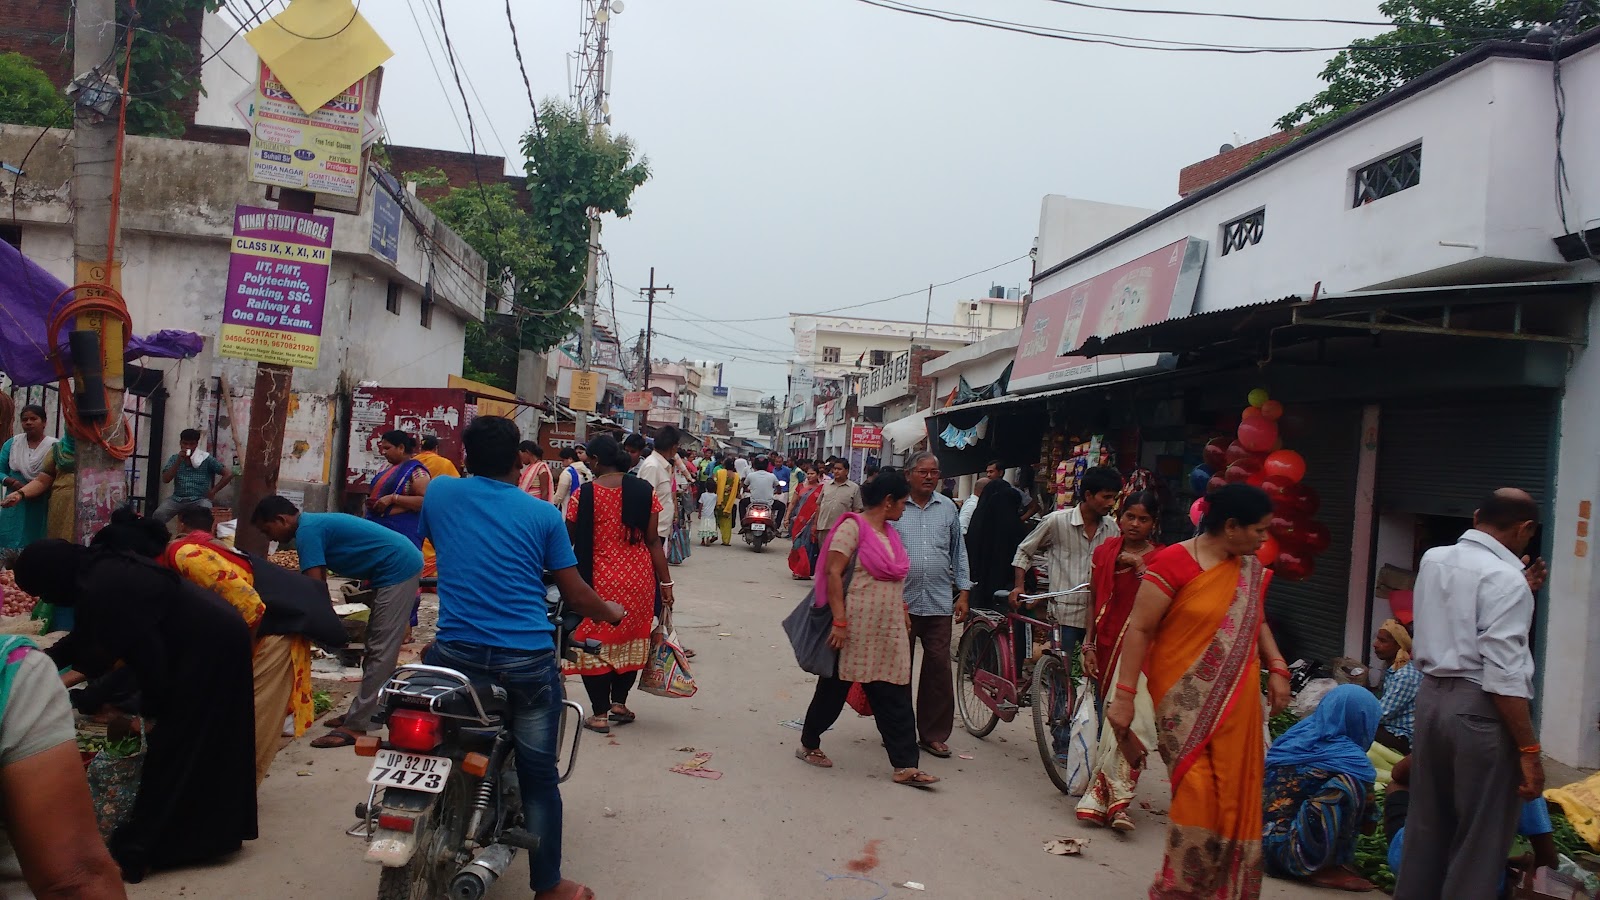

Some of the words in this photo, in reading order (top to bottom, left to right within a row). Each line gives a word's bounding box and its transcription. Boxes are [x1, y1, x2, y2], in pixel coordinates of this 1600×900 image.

[254, 163, 278, 172] INDIRA
[279, 167, 304, 176] NAGAR
[308, 172, 330, 181] GOMTI
[331, 176, 356, 186] NAGAR
[239, 214, 266, 230] VINAY
[267, 214, 296, 232] STUDY
[296, 218, 329, 242] CIRCLE
[236, 240, 267, 252] CLASS
[270, 244, 282, 256] IX,
[285, 246, 294, 256] X,
[297, 247, 309, 258] XI,
[312, 249, 325, 259] XII
[255, 261, 272, 274] IIT,
[275, 264, 301, 278] PMT,
[243, 272, 310, 292] Polytechnic,
[238, 284, 284, 300] Banking,
[287, 290, 313, 305] SSC,
[246, 298, 290, 314] Railway
[292, 304, 301, 314] &
[232, 308, 254, 320] One
[256, 312, 278, 326] Day
[279, 314, 313, 328] Exam.
[245, 328, 280, 338] CONTACT
[387, 754, 402, 767] UP
[405, 756, 420, 770] 32
[422, 758, 438, 772] DZ
[373, 766, 442, 788] 7473
